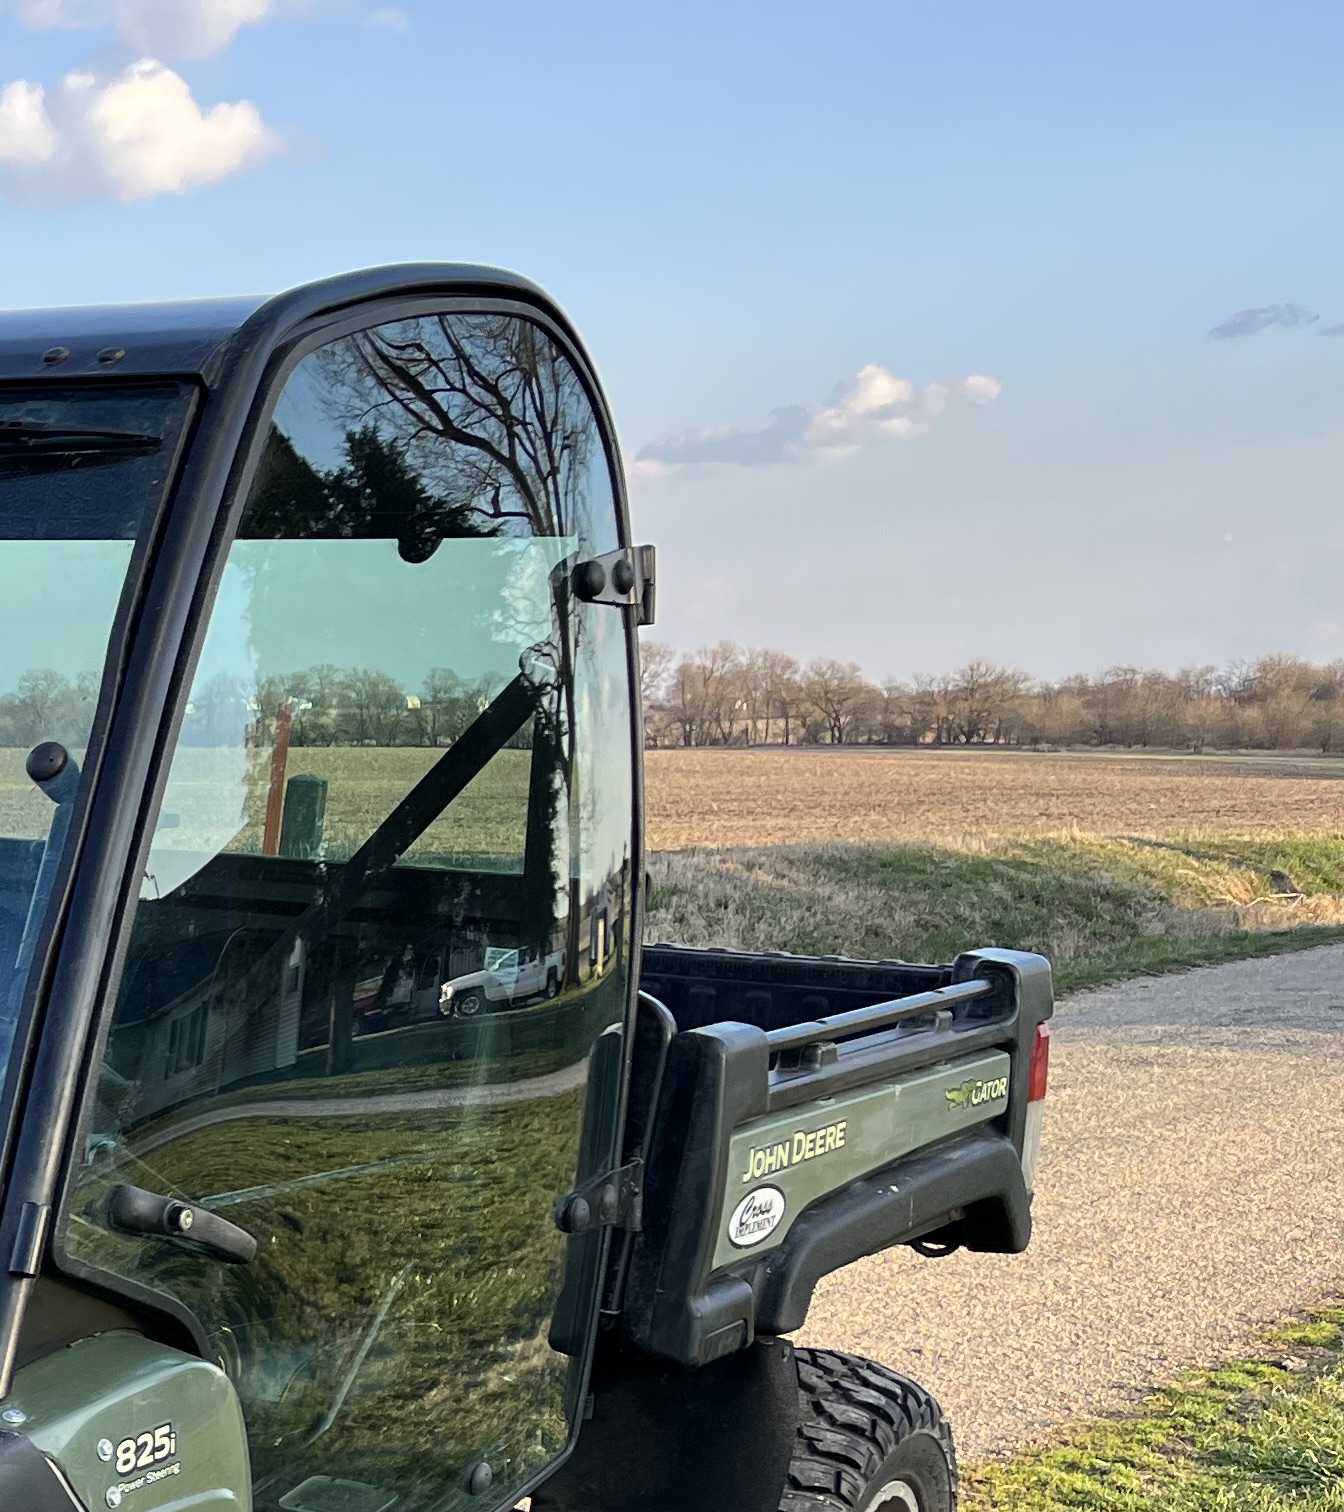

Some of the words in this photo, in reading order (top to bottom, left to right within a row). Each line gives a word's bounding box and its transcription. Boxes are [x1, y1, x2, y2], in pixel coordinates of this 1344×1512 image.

[972, 1077, 1008, 1105] GATOR
[741, 1141, 791, 1183] JOHN
[792, 1120, 847, 1165] DEERE
[115, 1422, 176, 1477] 825i
[118, 1477, 145, 1494] Power
